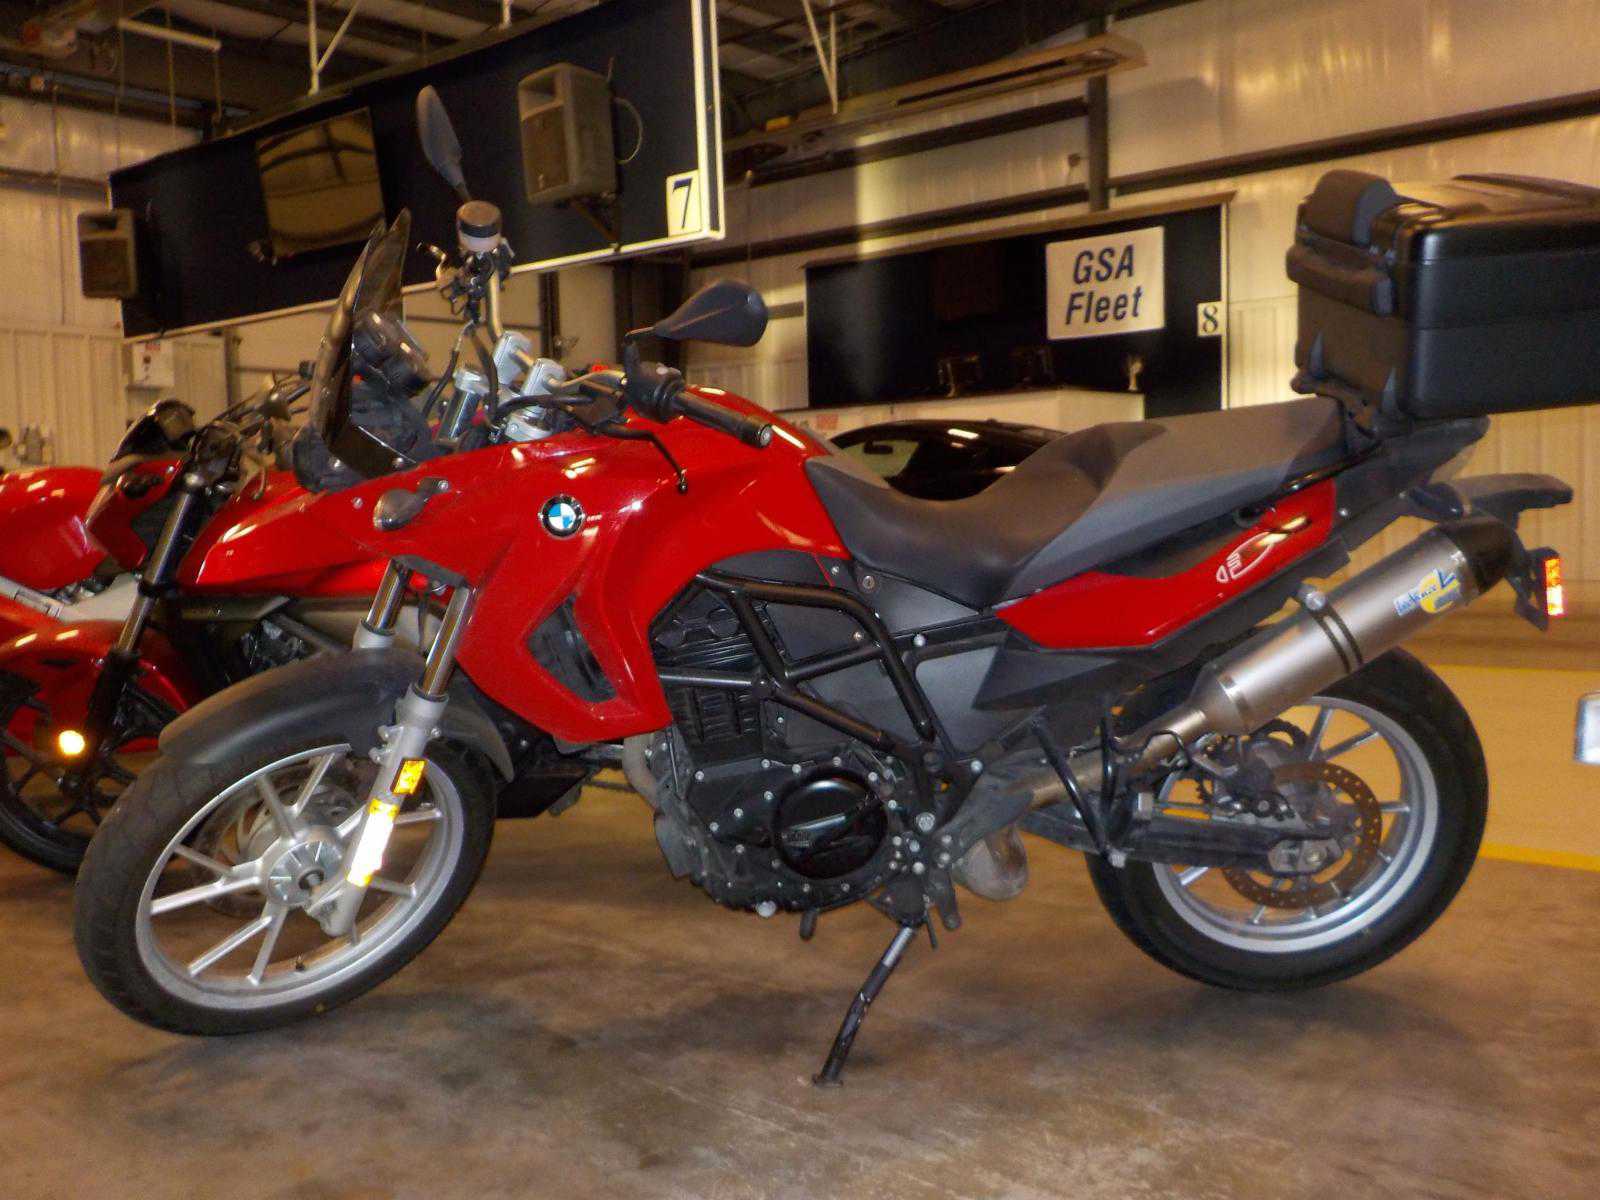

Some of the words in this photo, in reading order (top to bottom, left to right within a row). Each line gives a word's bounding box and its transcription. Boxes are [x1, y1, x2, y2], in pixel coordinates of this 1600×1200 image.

[672, 177, 693, 230] 7
[1072, 244, 1135, 285] GSA
[1065, 286, 1144, 325] Fleet
[1202, 305, 1219, 334] 8
